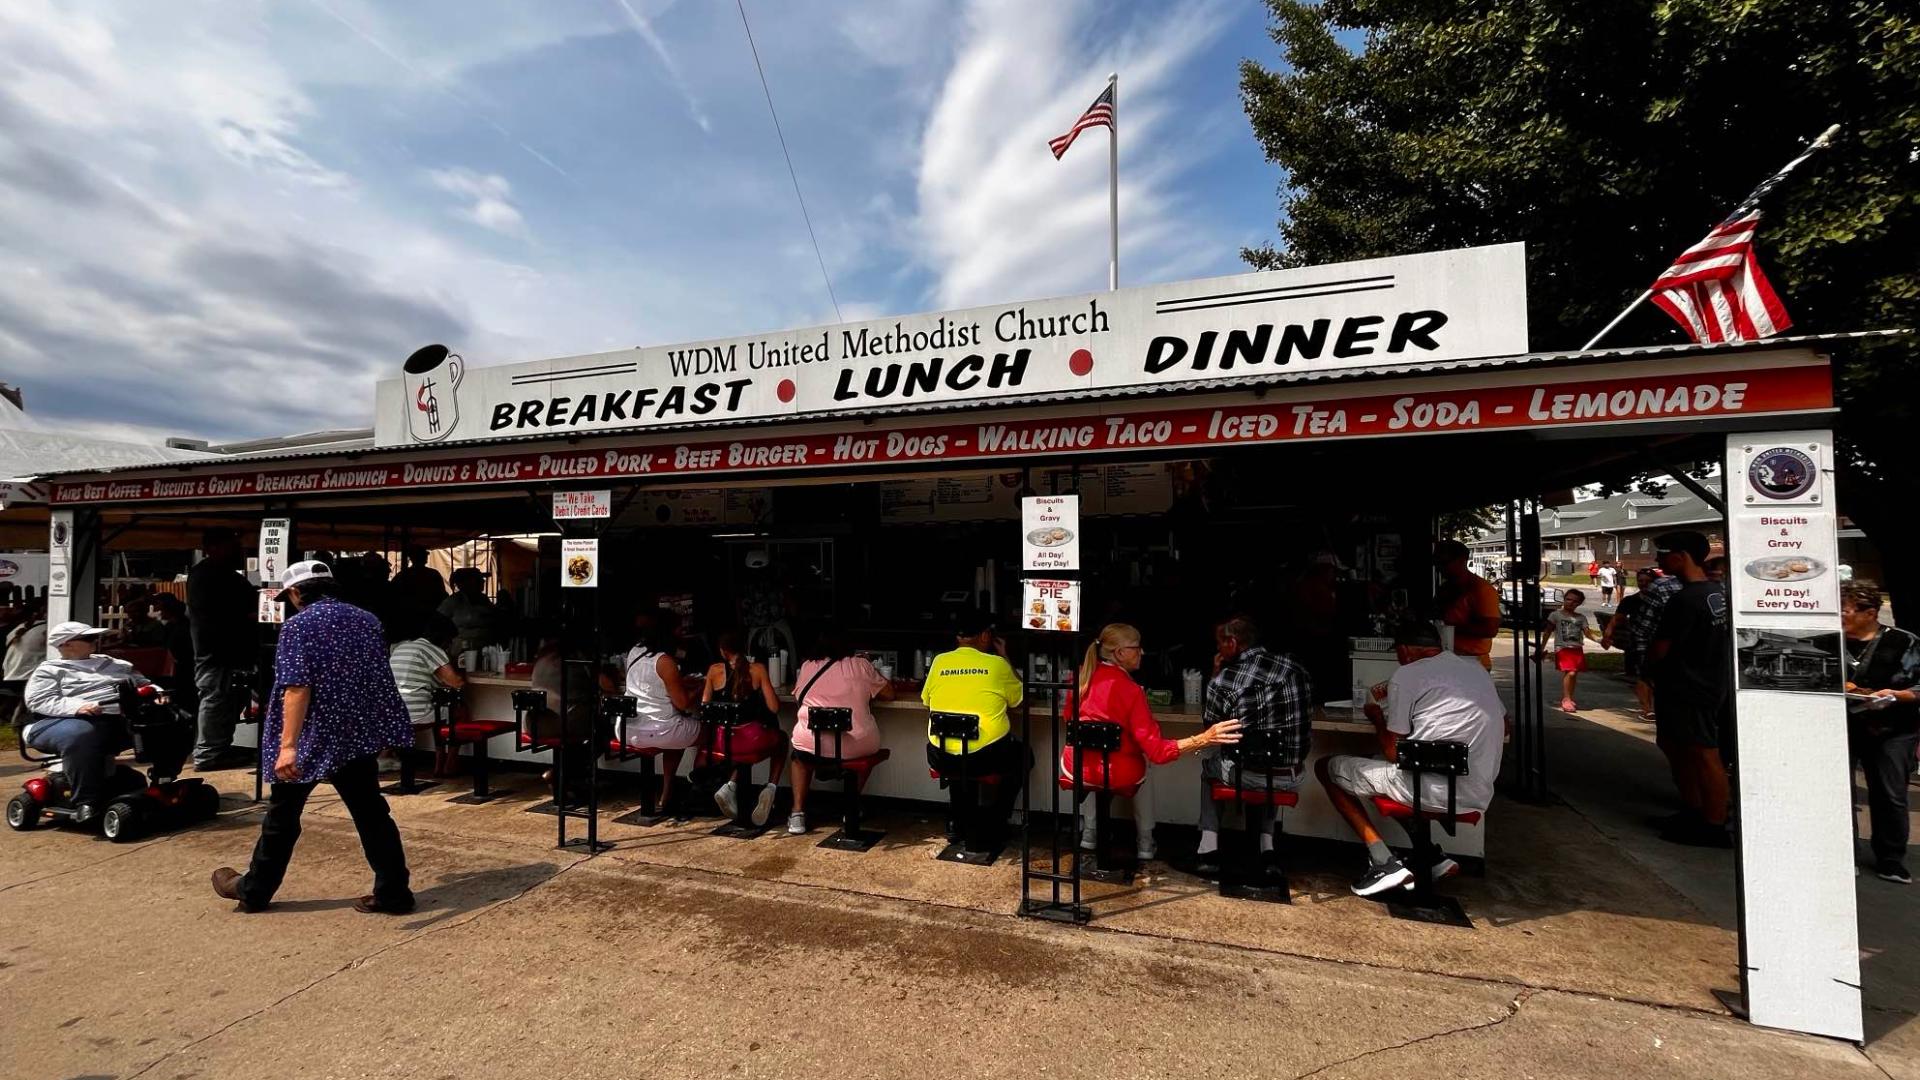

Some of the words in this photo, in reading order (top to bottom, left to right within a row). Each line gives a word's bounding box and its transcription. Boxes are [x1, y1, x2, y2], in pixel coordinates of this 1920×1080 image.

[668, 344, 737, 377] WDM
[748, 332, 829, 370] United
[842, 319, 981, 360] Methodist
[995, 299, 1110, 343] Church
[1143, 310, 1448, 374] DINNER
[833, 348, 1032, 401] LUNCH
[489, 378, 752, 432] BREAKFAST
[84, 483, 106, 500] BEST
[108, 481, 142, 499] COFFEE
[153, 479, 195, 497] BISCUITS
[197, 481, 204, 494] &
[209, 476, 243, 494] GRAVY
[255, 473, 319, 492] BREAKFAST
[322, 469, 388, 489] SANDWICH
[403, 461, 456, 483] DONUTS
[460, 462, 470, 479] &
[476, 459, 519, 480] ROLLS
[538, 455, 599, 477] PULLED
[604, 450, 654, 474] PORK
[674, 446, 722, 469] BEEF
[728, 443, 808, 467] BURGER
[833, 434, 880, 460] HOT
[886, 432, 949, 457] DOGS
[977, 426, 1095, 453] WALKING
[1105, 417, 1172, 445] TACO
[1207, 410, 1279, 440] ICED
[1291, 405, 1348, 435] TEA
[1388, 397, 1481, 430] SODA
[1527, 382, 1748, 422] LEMONADE
[567, 492, 578, 504] We
[580, 492, 595, 503] Take
[592, 504, 607, 515] Cards
[264, 520, 285, 528] SERVING
[1760, 517, 1808, 525] Biscuits
[1780, 528, 1788, 536] &
[265, 537, 280, 546] SINCE
[1768, 539, 1802, 549] Gravy
[1048, 552, 1064, 560] Day!
[1039, 588, 1063, 599] PIE
[1765, 588, 1780, 597] All
[1784, 588, 1810, 599] Day!
[1756, 600, 1789, 610] Every
[1793, 600, 1820, 610] Day!
[940, 668, 989, 676] ADMISSIONS
